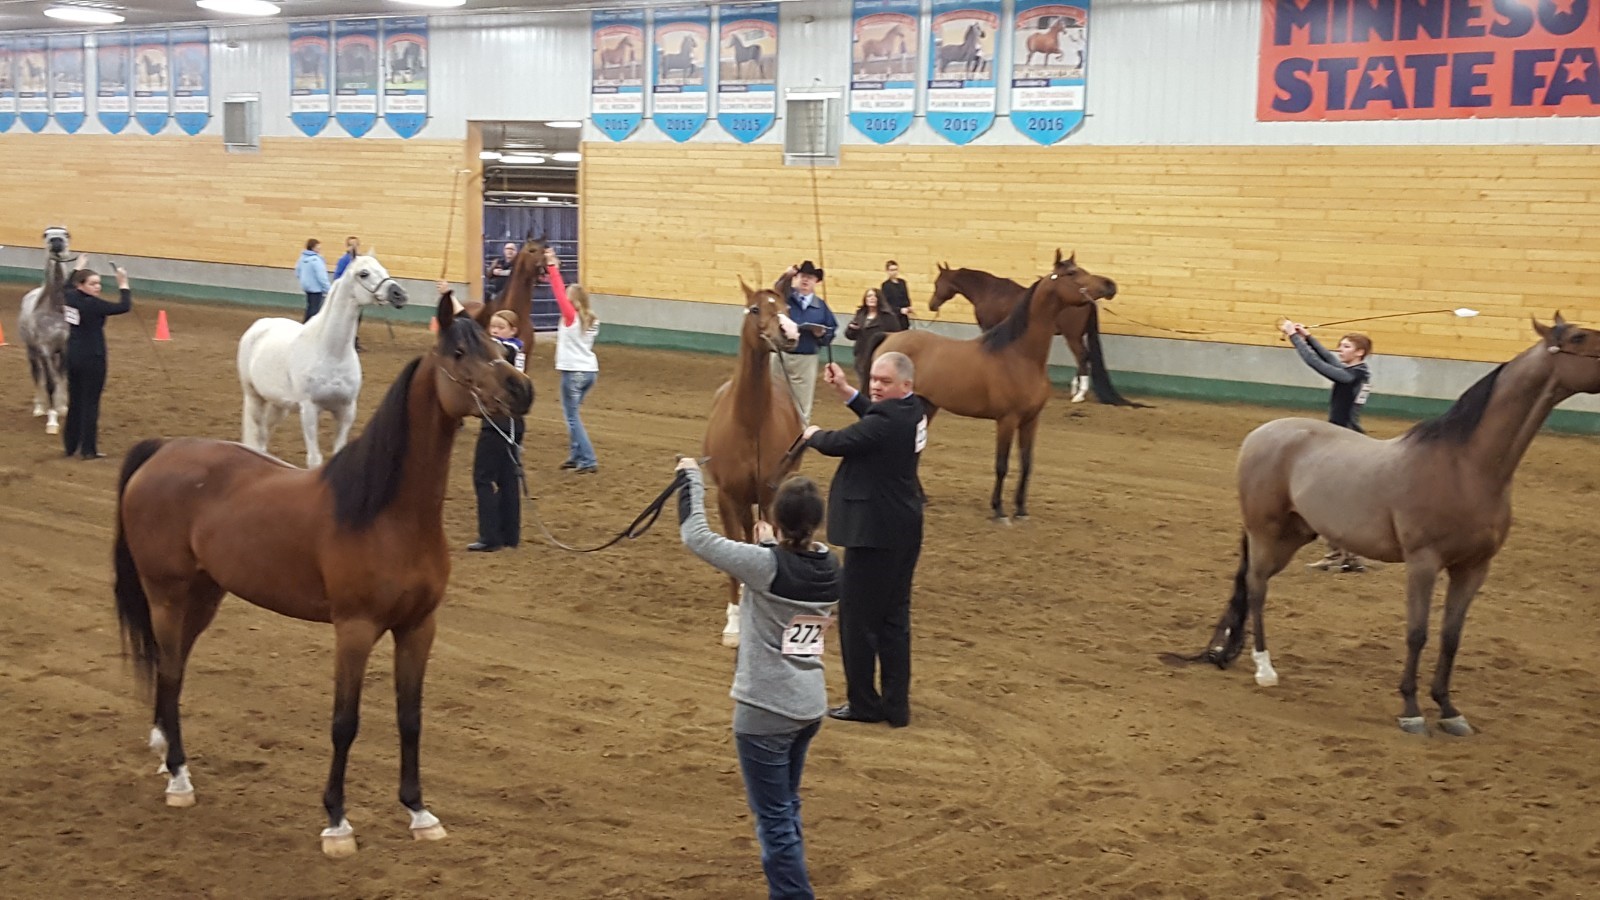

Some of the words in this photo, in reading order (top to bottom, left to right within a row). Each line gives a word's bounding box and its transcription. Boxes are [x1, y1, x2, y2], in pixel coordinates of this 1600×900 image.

[1271, 51, 1495, 113] STATE
[1510, 47, 1600, 106] FA
[604, 118, 630, 131] 2015
[732, 118, 761, 131] 2015
[865, 117, 897, 131] 2016
[943, 117, 978, 131] 2016
[1027, 116, 1065, 131] 2016
[790, 623, 822, 643] 272
